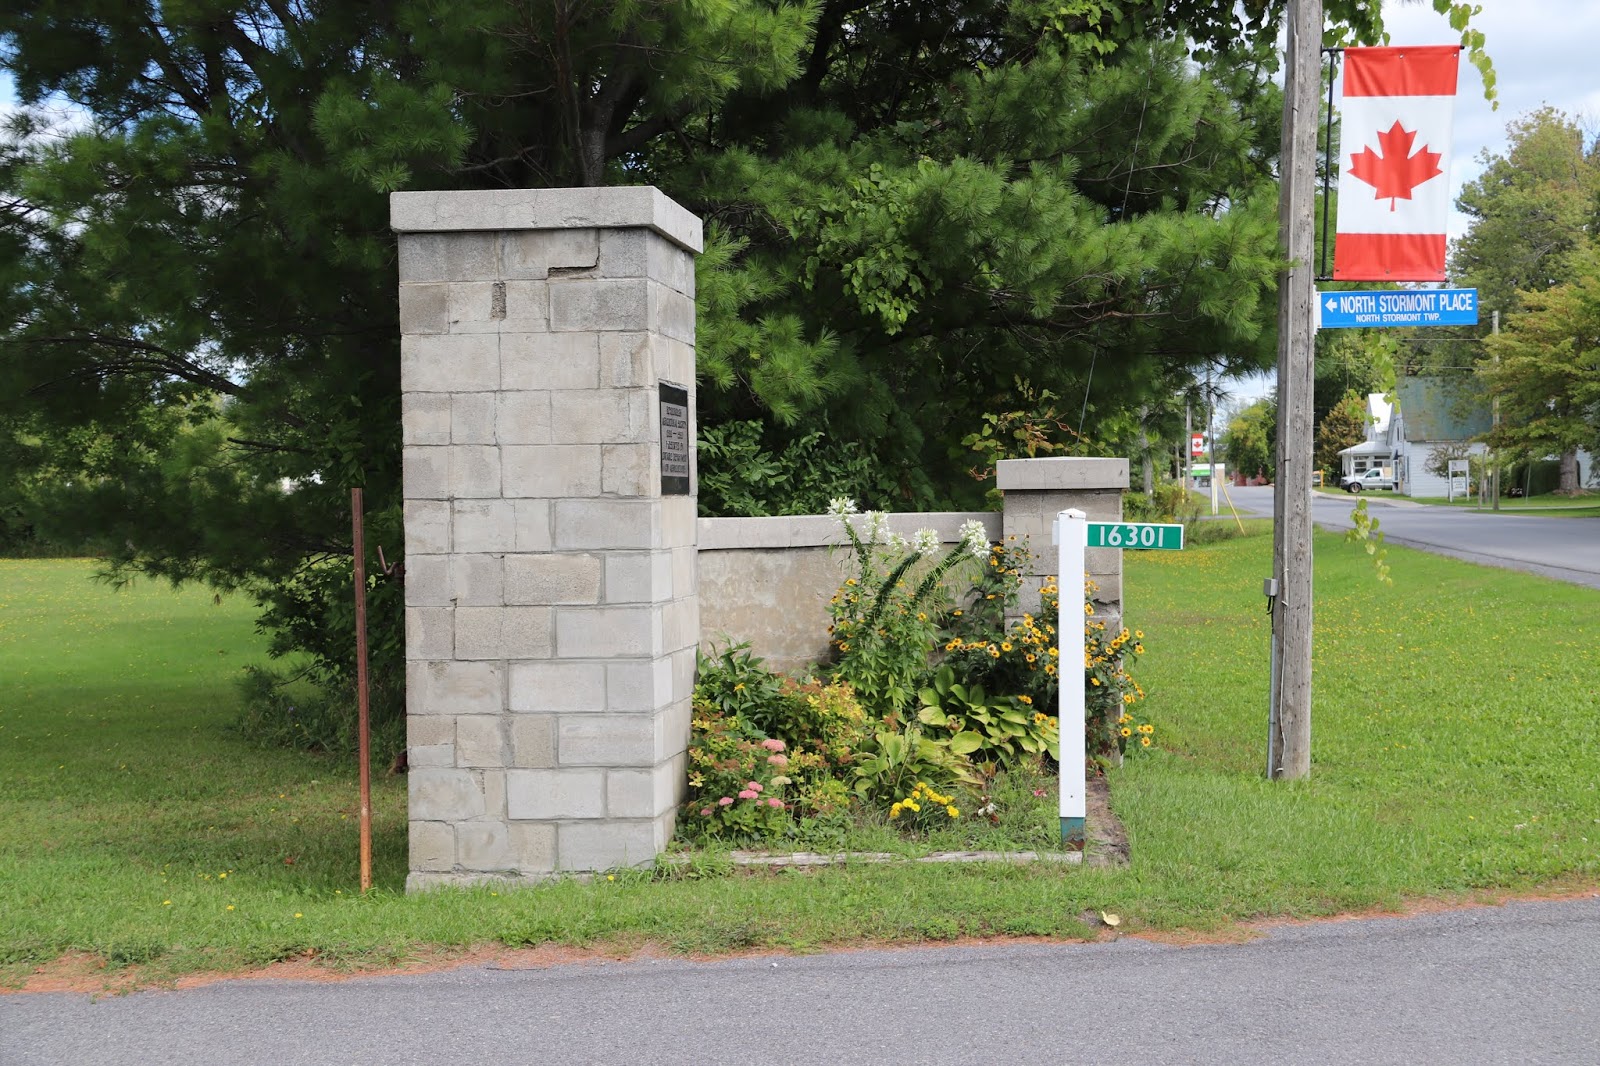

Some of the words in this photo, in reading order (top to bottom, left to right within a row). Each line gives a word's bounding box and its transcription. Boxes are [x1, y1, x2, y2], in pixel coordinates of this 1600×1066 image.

[1340, 296, 1376, 313] NORTH
[1379, 294, 1436, 312] STORMONT
[1440, 294, 1473, 311] PLACE
[1356, 314, 1380, 322] NORTH
[1383, 313, 1421, 322] STORMONT
[1424, 313, 1441, 321] TWP.
[1100, 526, 1164, 547] 16301
